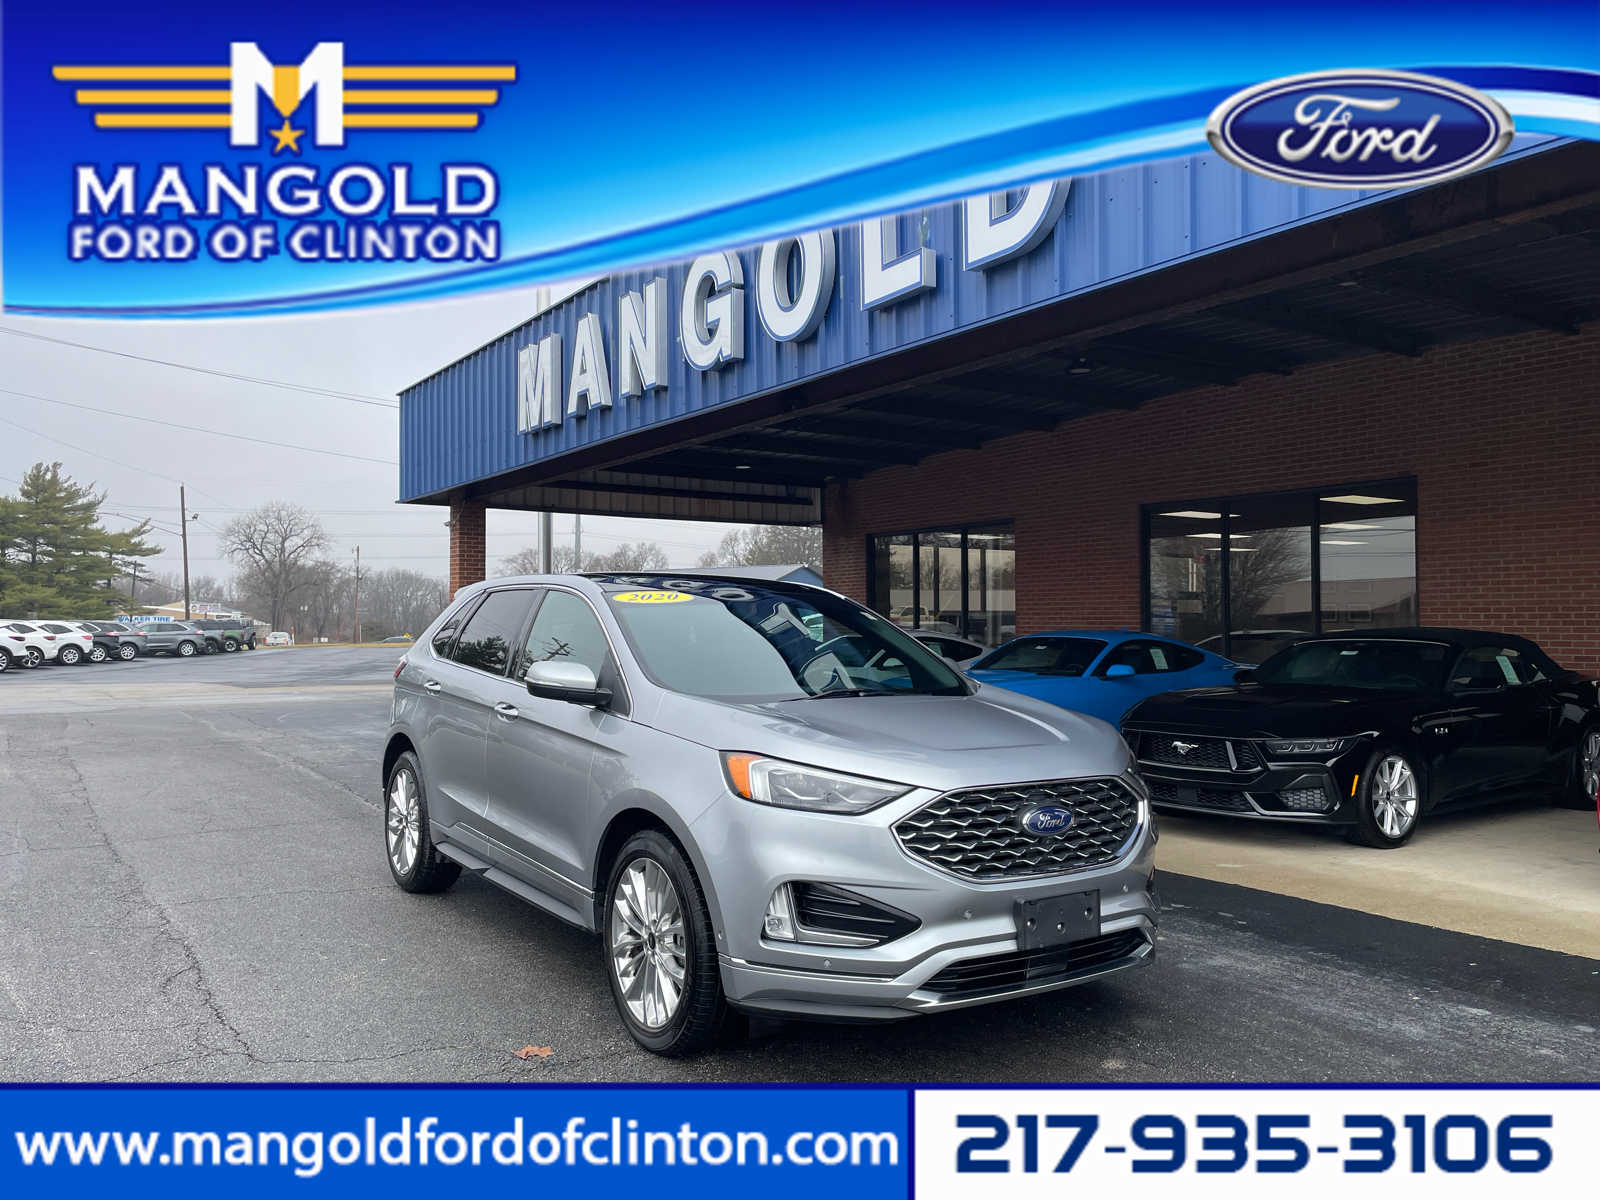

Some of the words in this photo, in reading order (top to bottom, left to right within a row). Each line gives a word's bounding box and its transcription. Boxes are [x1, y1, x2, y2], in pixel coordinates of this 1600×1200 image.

[628, 593, 679, 601] 2020
[118, 615, 151, 623] WAKER
[1038, 812, 1065, 829] Ford
